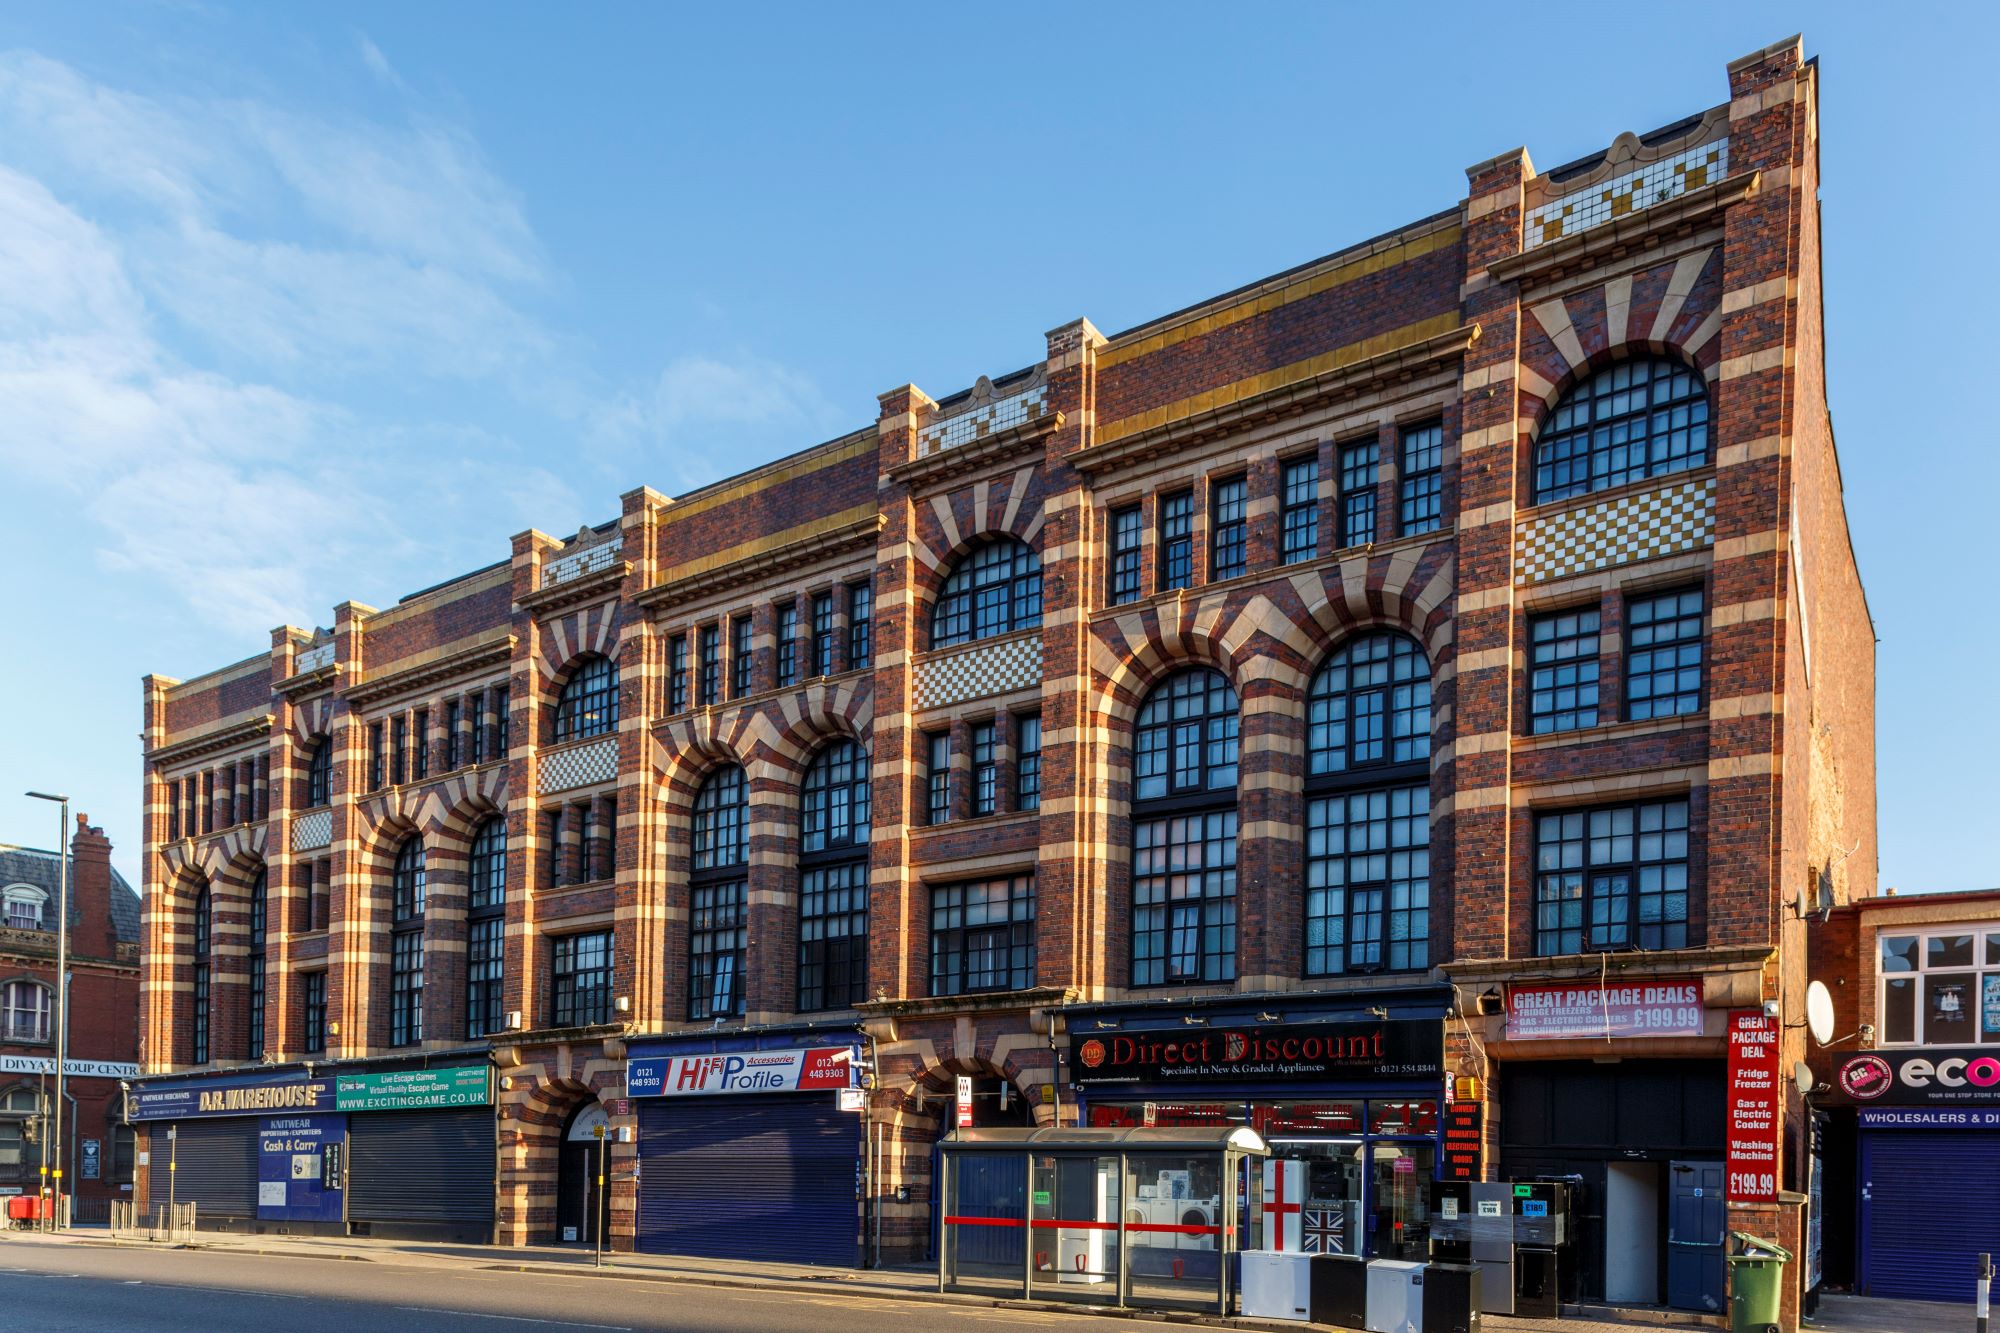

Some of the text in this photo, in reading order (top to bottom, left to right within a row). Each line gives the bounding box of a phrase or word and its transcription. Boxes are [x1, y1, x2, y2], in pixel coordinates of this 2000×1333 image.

[1514, 986, 1697, 1009] GREAT PACKAGE DEALS
[1551, 1007, 1591, 1015] FREEZERS
[1634, 1008, 1698, 1027] £199.99
[1739, 1017, 1768, 1028] GREAT
[1732, 1032, 1775, 1043] PACKAGE
[1111, 1030, 1384, 1064] Direct Discount
[1742, 1047, 1765, 1057] DEAL
[1087, 1048, 1099, 1059] DD
[6, 1059, 45, 1070] DIVYA
[747, 1055, 795, 1064] Accessories
[817, 1059, 835, 1067] 0121
[721, 1056, 783, 1089] Profile
[809, 1069, 844, 1078] 448 9303
[1161, 1063, 1324, 1076] Specialist In New & Graded Appliances
[1738, 1070, 1768, 1079] Fridge
[1900, 1057, 2000, 1087] eco
[394, 1075, 414, 1083] Escape
[1735, 1080, 1771, 1088] Freezer
[370, 1083, 449, 1094] Virtual Reality Escape Game
[226, 1085, 316, 1110] WAREHOUSE
[339, 1092, 484, 1108] WWW.EXCITINGGAME.CO.UK
[1737, 1099, 1755, 1108] Gas
[1734, 1110, 1772, 1118] Electric
[1865, 1114, 2000, 1123] WHOLESALERS & DI
[271, 1119, 310, 1128] KNITWEAR
[1735, 1120, 1770, 1129] Cooker
[1447, 1130, 1479, 1138] UNWANTED
[264, 1139, 317, 1153] Cash & Carry
[1732, 1141, 1773, 1151] Washing
[1731, 1151, 1773, 1160] Machine
[1731, 1172, 1773, 1195] £199.99
